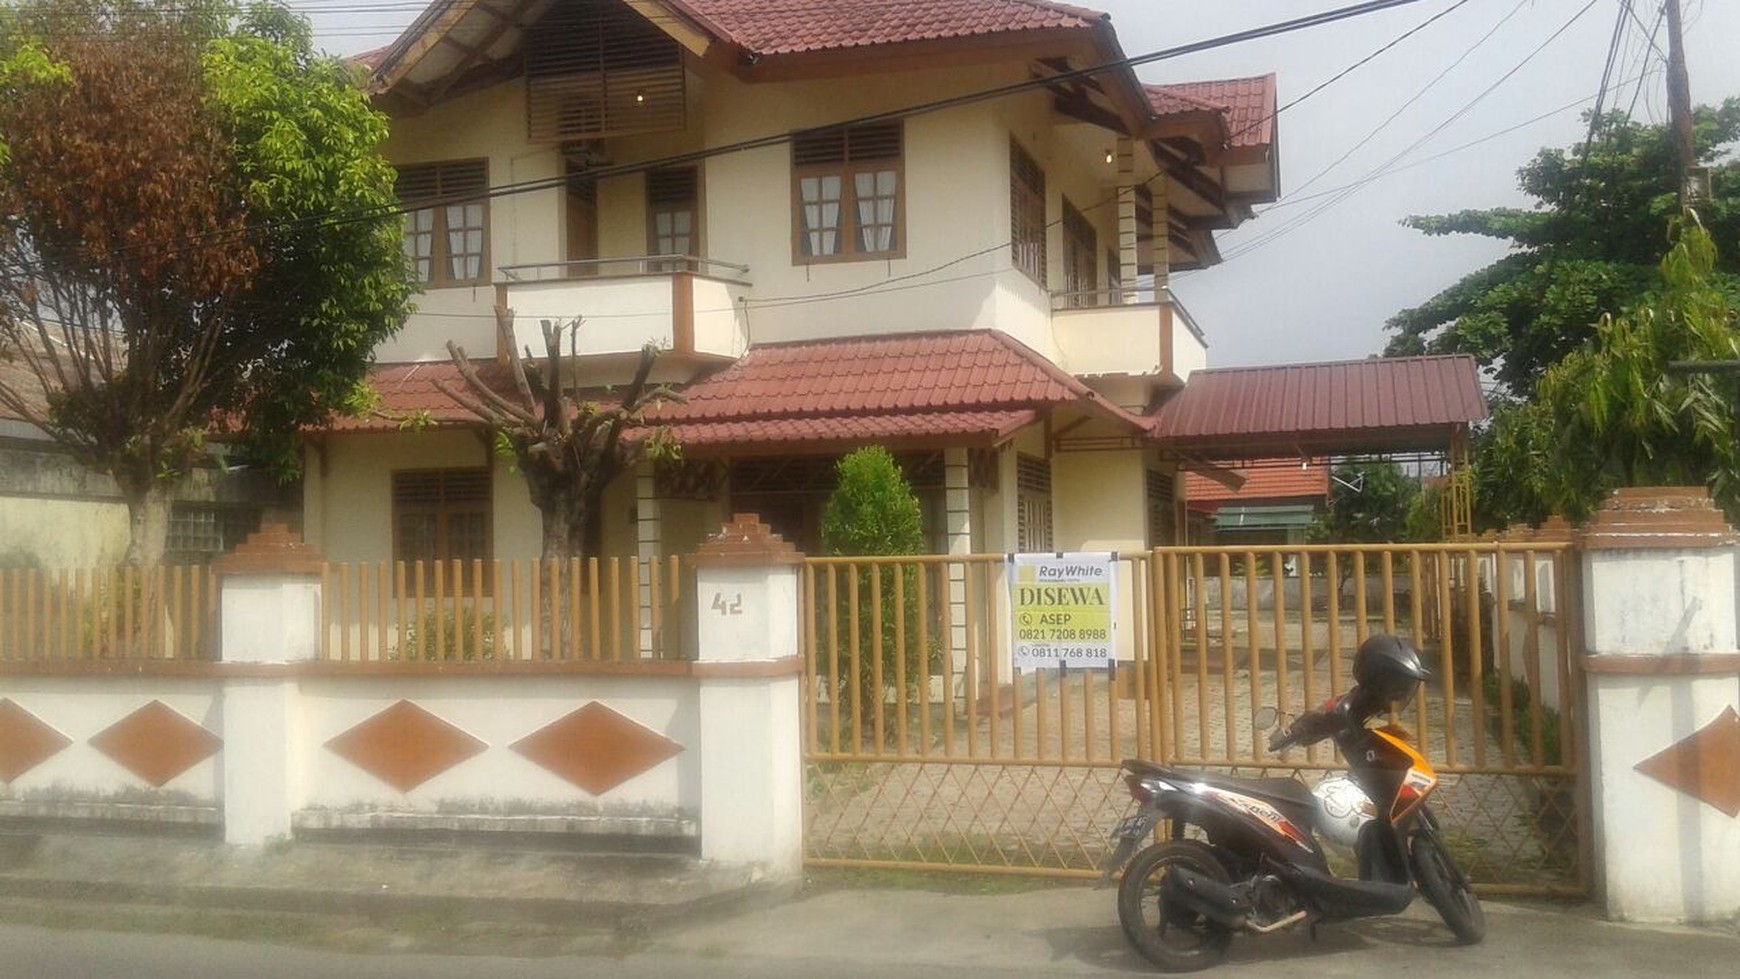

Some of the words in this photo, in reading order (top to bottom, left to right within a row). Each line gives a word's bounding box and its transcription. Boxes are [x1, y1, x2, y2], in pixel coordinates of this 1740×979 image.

[1020, 587, 1104, 606] DISEWA
[711, 592, 743, 616] 42
[1040, 613, 1071, 625] ASEP
[1019, 629, 1046, 640] 0821
[1050, 629, 1076, 640] 7208
[1079, 629, 1106, 640] 8988
[1031, 648, 1059, 658] 0811
[1063, 648, 1083, 658] 768
[1086, 648, 1107, 658] 818
